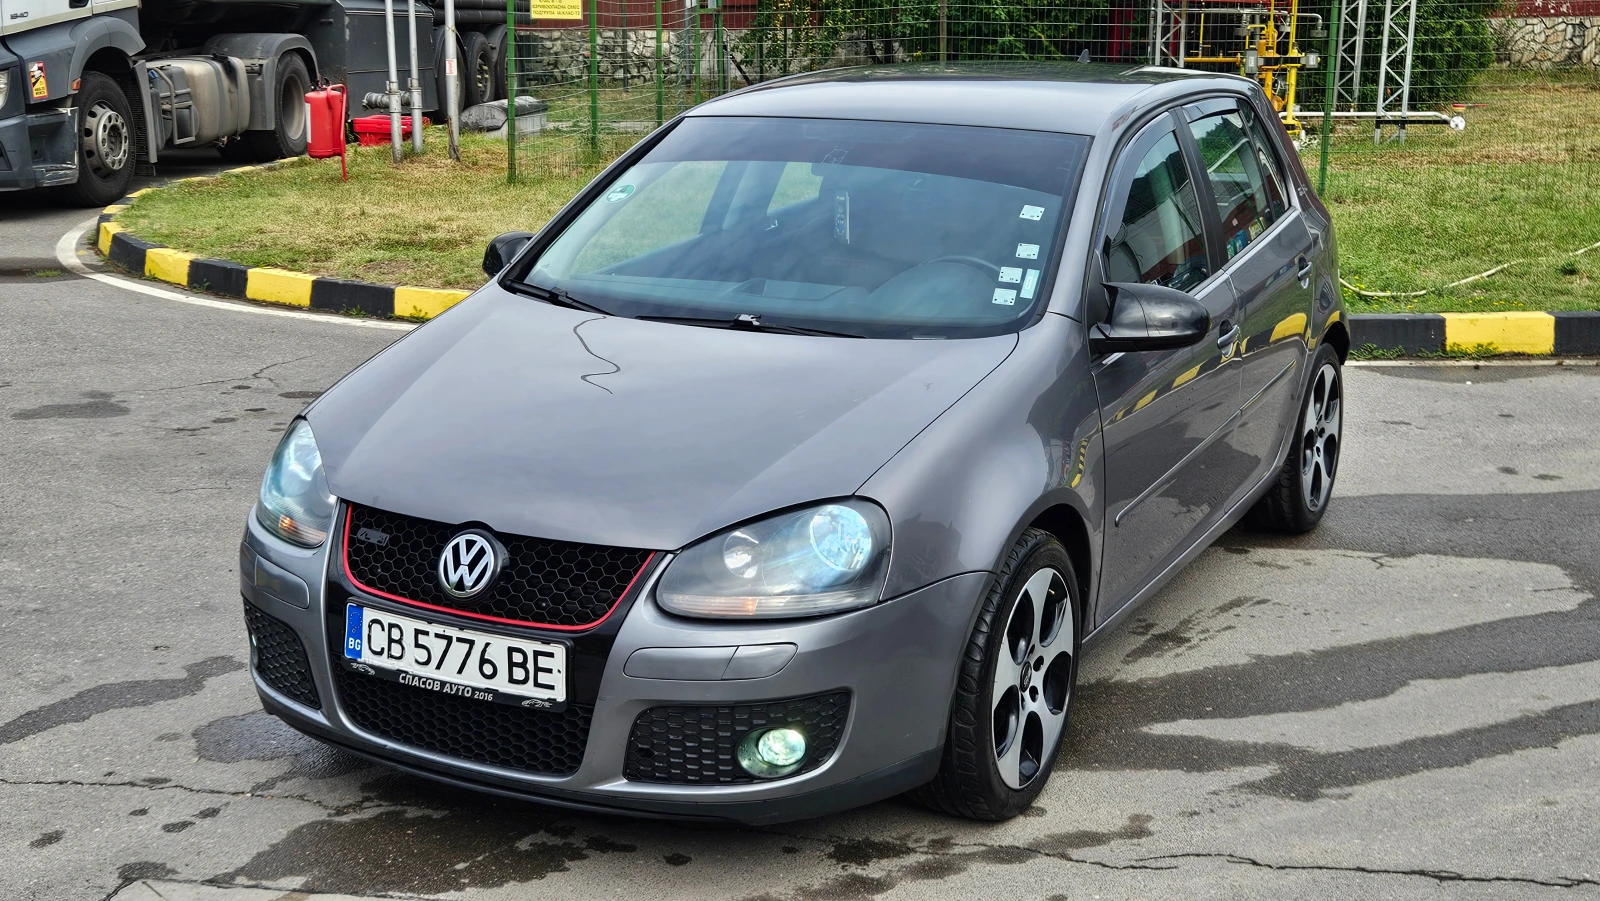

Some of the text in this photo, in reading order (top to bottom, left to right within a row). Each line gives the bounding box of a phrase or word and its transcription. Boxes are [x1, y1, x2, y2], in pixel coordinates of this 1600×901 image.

[348, 637, 361, 651] BG
[414, 627, 499, 681] 5776
[399, 673, 494, 701] СПАСОВ АУТО 2016
